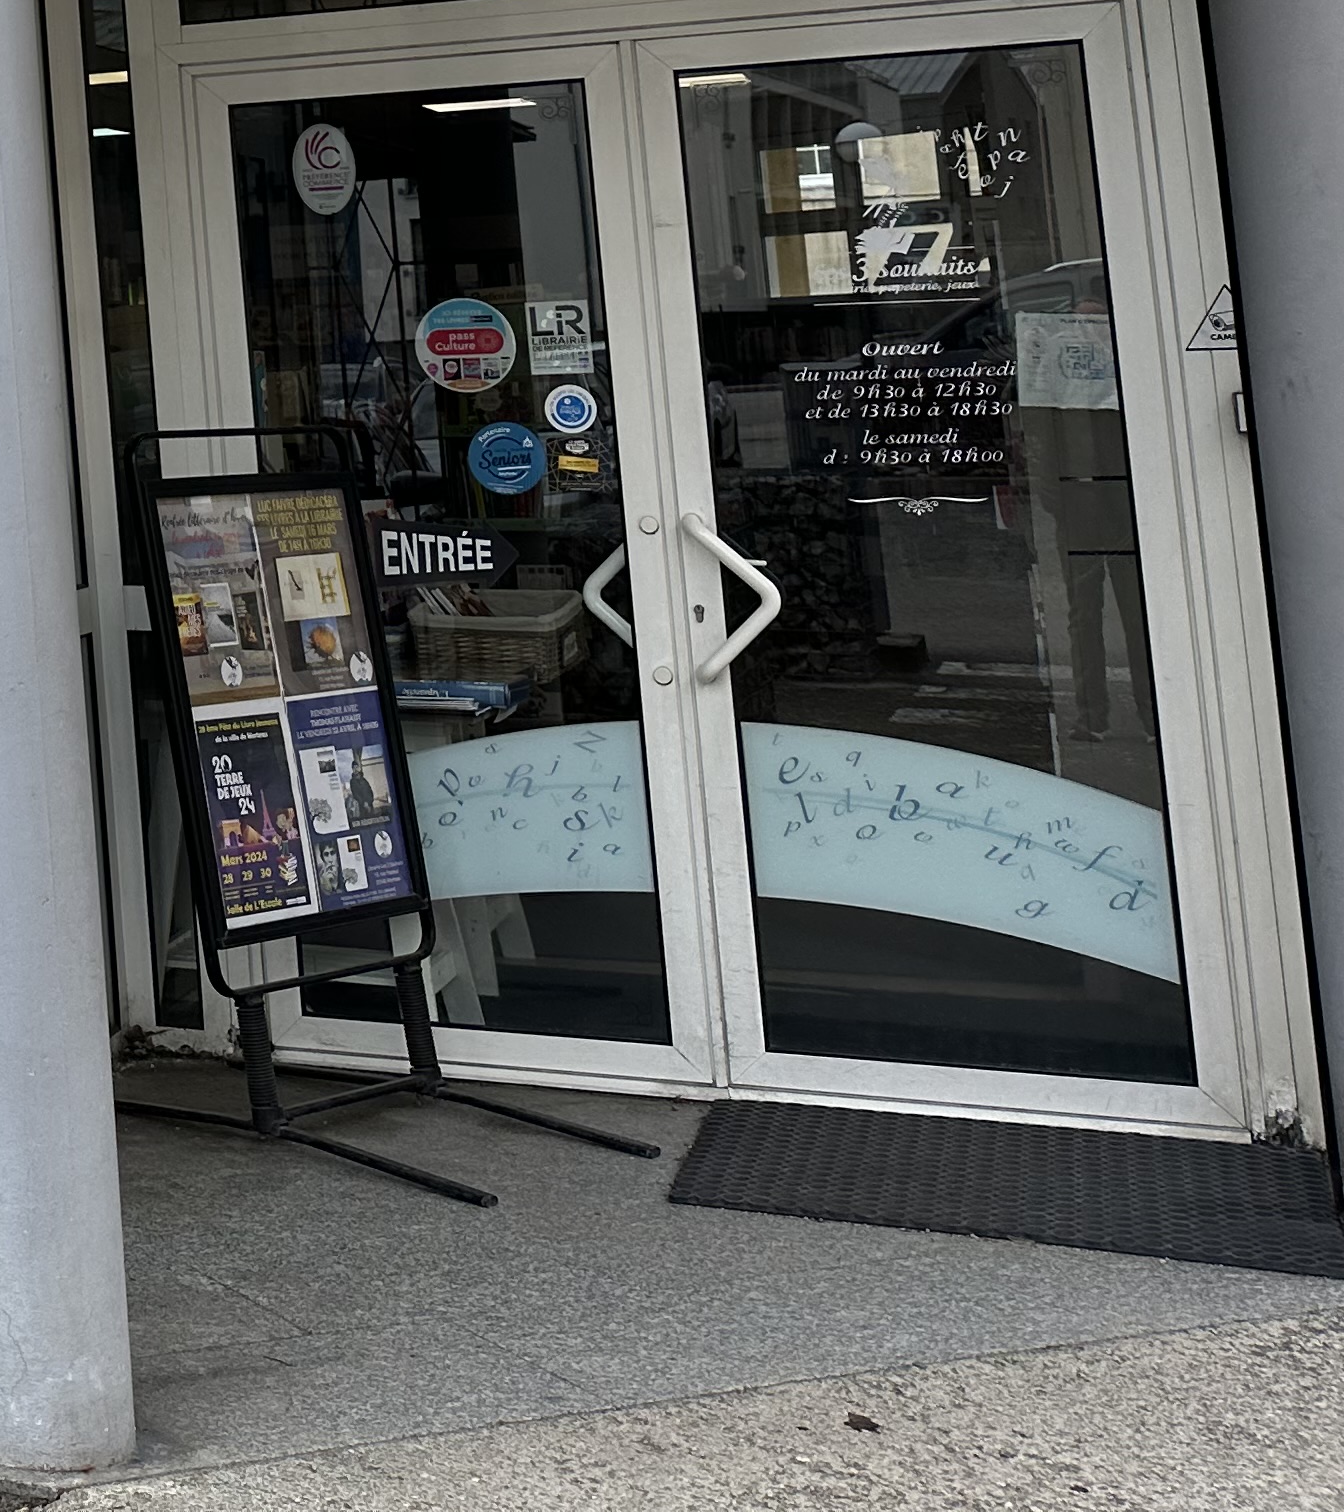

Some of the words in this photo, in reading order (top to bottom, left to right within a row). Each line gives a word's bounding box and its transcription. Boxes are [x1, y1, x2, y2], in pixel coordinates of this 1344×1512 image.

[448, 331, 475, 341] pass
[435, 341, 476, 351] Culture
[862, 341, 945, 357] Ouvert
[794, 366, 821, 383] du
[827, 364, 889, 381] mardi
[894, 367, 922, 380] au
[927, 360, 1018, 378] vendredi
[816, 384, 844, 400] de
[852, 382, 906, 400] 9h30
[912, 383, 924, 398] à
[935, 381, 997, 398] 12h30
[805, 406, 824, 419] et
[827, 403, 851, 419] de
[860, 401, 921, 418] 13h30
[927, 402, 944, 417] à
[950, 399, 1013, 416] 18h30
[862, 429, 881, 445] le
[885, 427, 960, 445] samedi
[478, 449, 533, 470] Seniors
[860, 447, 912, 465] 9h30
[918, 448, 931, 463] à
[941, 446, 1004, 463] 18h00
[381, 530, 494, 576] ENTRÉE
[211, 754, 233, 774] 20
[214, 771, 245, 787] TERRE
[217, 786, 231, 800] DE
[231, 783, 253, 799] JEUX
[238, 798, 256, 815] 24
[220, 853, 244, 867] Mars
[244, 849, 268, 864] 2024
[260, 867, 272, 879] 30
